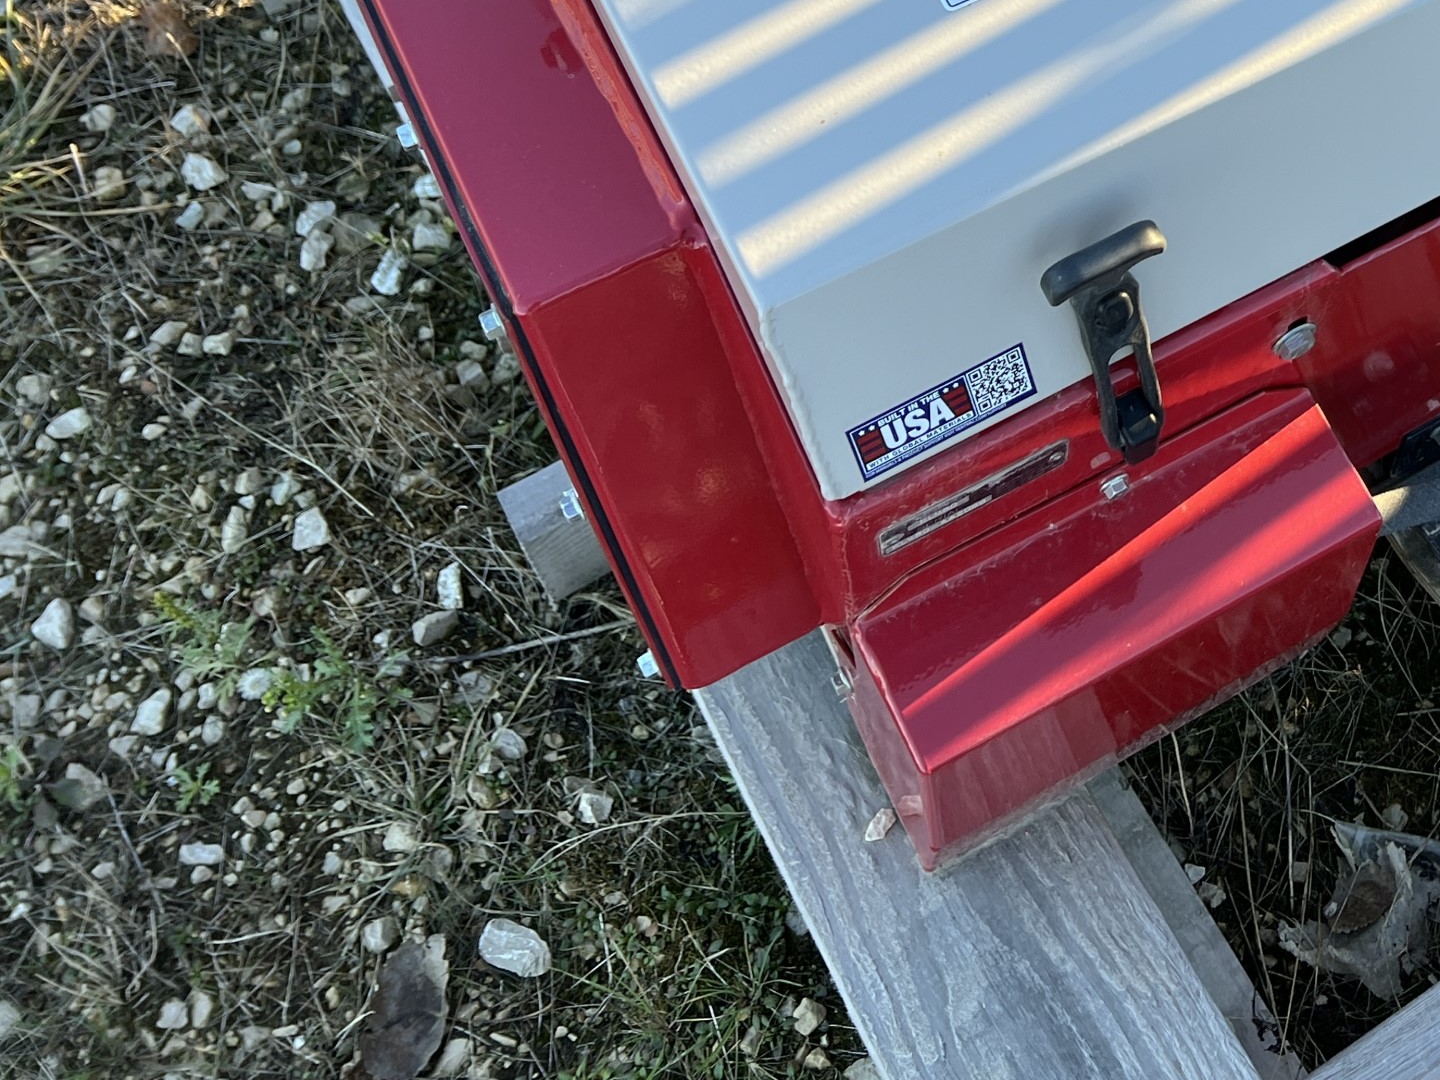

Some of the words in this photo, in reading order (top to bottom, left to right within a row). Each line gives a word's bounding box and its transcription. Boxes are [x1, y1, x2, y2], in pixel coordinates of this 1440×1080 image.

[878, 410, 906, 427] BUILT
[907, 401, 920, 412] IN
[919, 392, 941, 407] THE
[880, 398, 955, 450] USA
[868, 453, 891, 469] WITH
[892, 438, 924, 457] GLOBAL
[926, 412, 973, 438] MATERIALS
